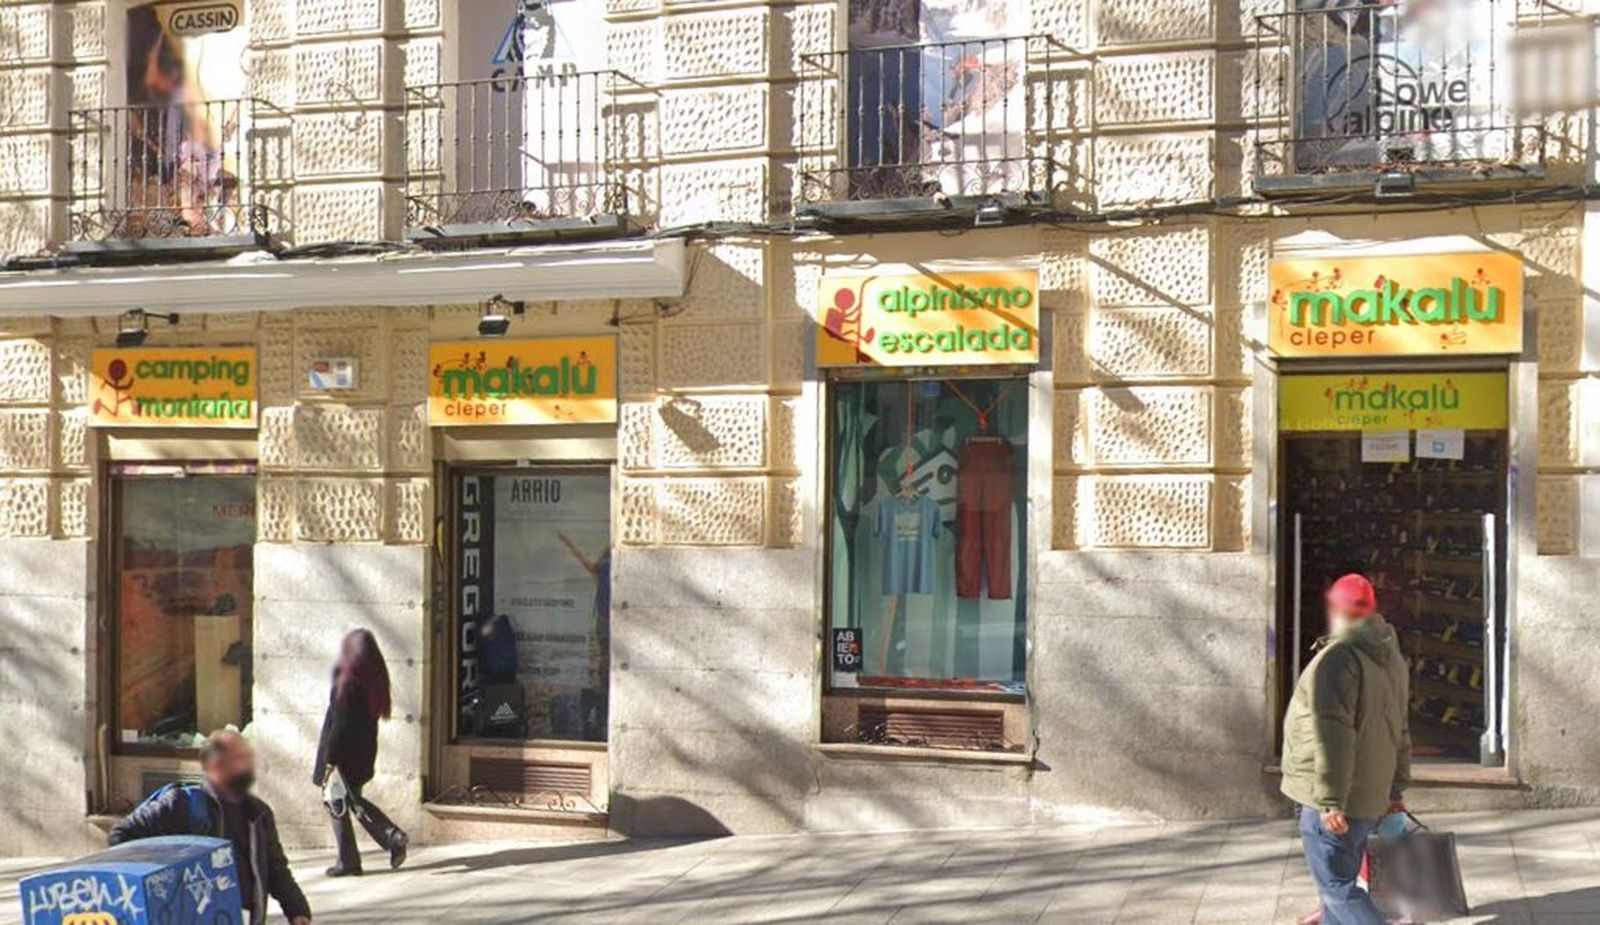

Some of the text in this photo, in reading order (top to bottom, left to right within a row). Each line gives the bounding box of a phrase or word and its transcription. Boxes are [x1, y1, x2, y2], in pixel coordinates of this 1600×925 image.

[175, 10, 233, 31] CASSIN
[1374, 78, 1468, 107] Lowe
[1343, 104, 1453, 141] alpine
[878, 283, 1033, 318] alpinismo
[878, 323, 1032, 354] escalada
[1290, 328, 1376, 348] cleper
[135, 356, 250, 387] camping
[444, 401, 508, 419] cleper
[511, 478, 562, 503] ARRIO
[836, 630, 855, 641] AB
[836, 653, 855, 665] TO
